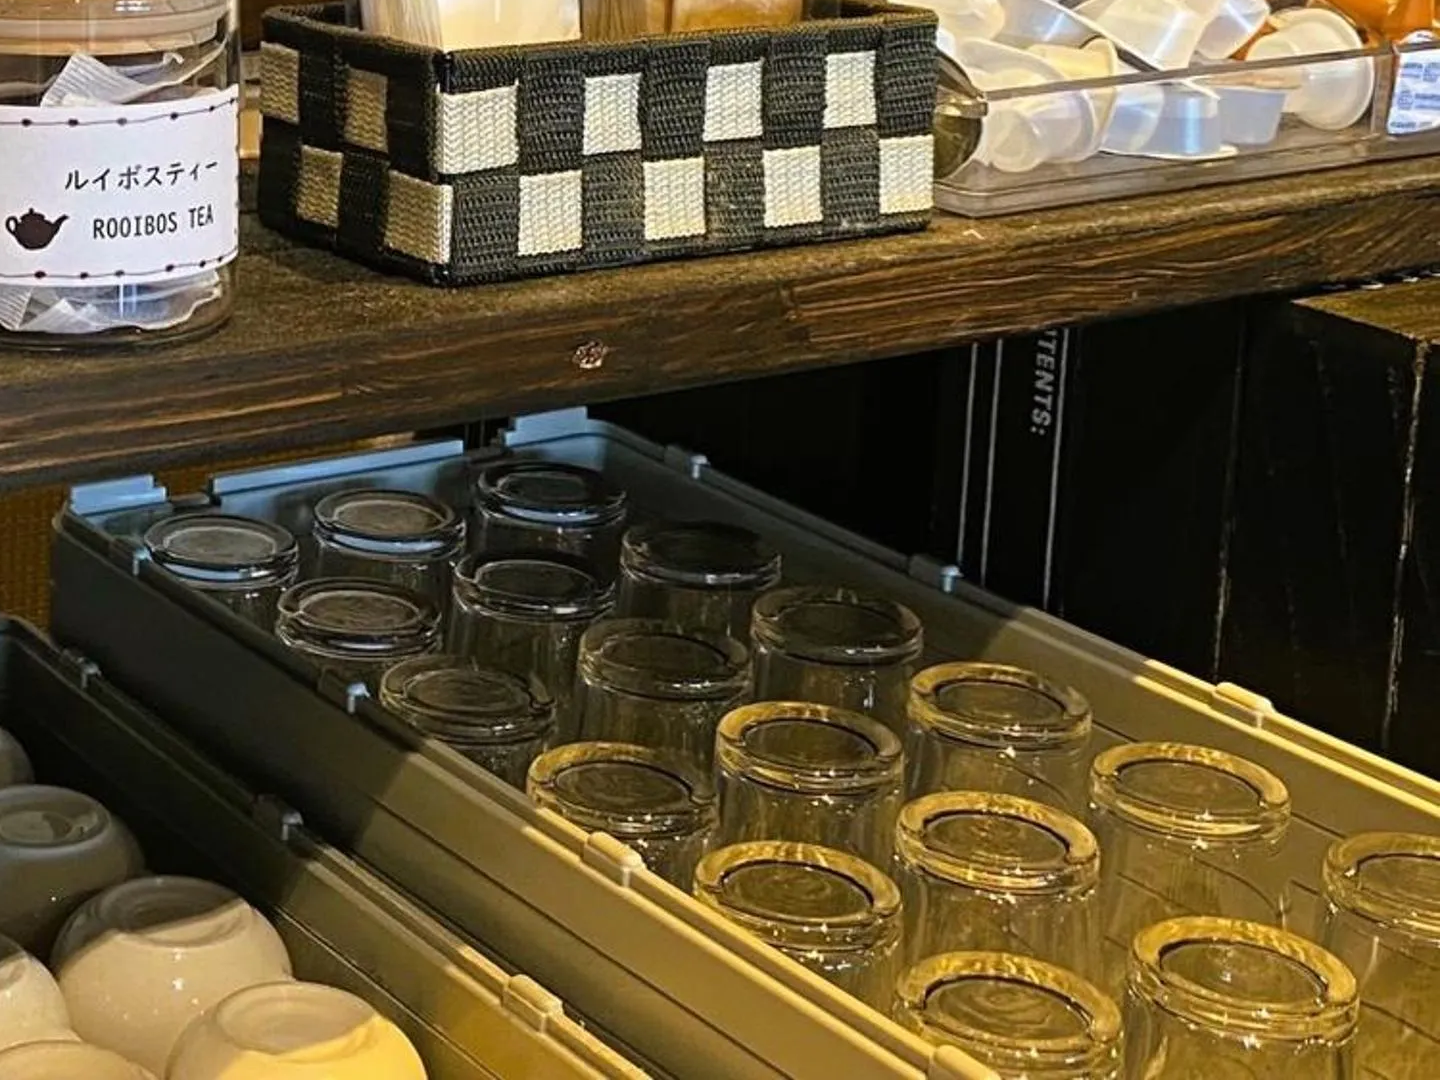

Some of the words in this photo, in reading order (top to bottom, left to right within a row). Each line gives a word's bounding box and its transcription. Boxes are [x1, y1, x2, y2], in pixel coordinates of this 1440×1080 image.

[64, 161, 218, 192] ルイボスティー
[92, 211, 178, 239] ROOIBOS
[188, 204, 214, 229] TEA
[1029, 329, 1059, 437] TENTS:
